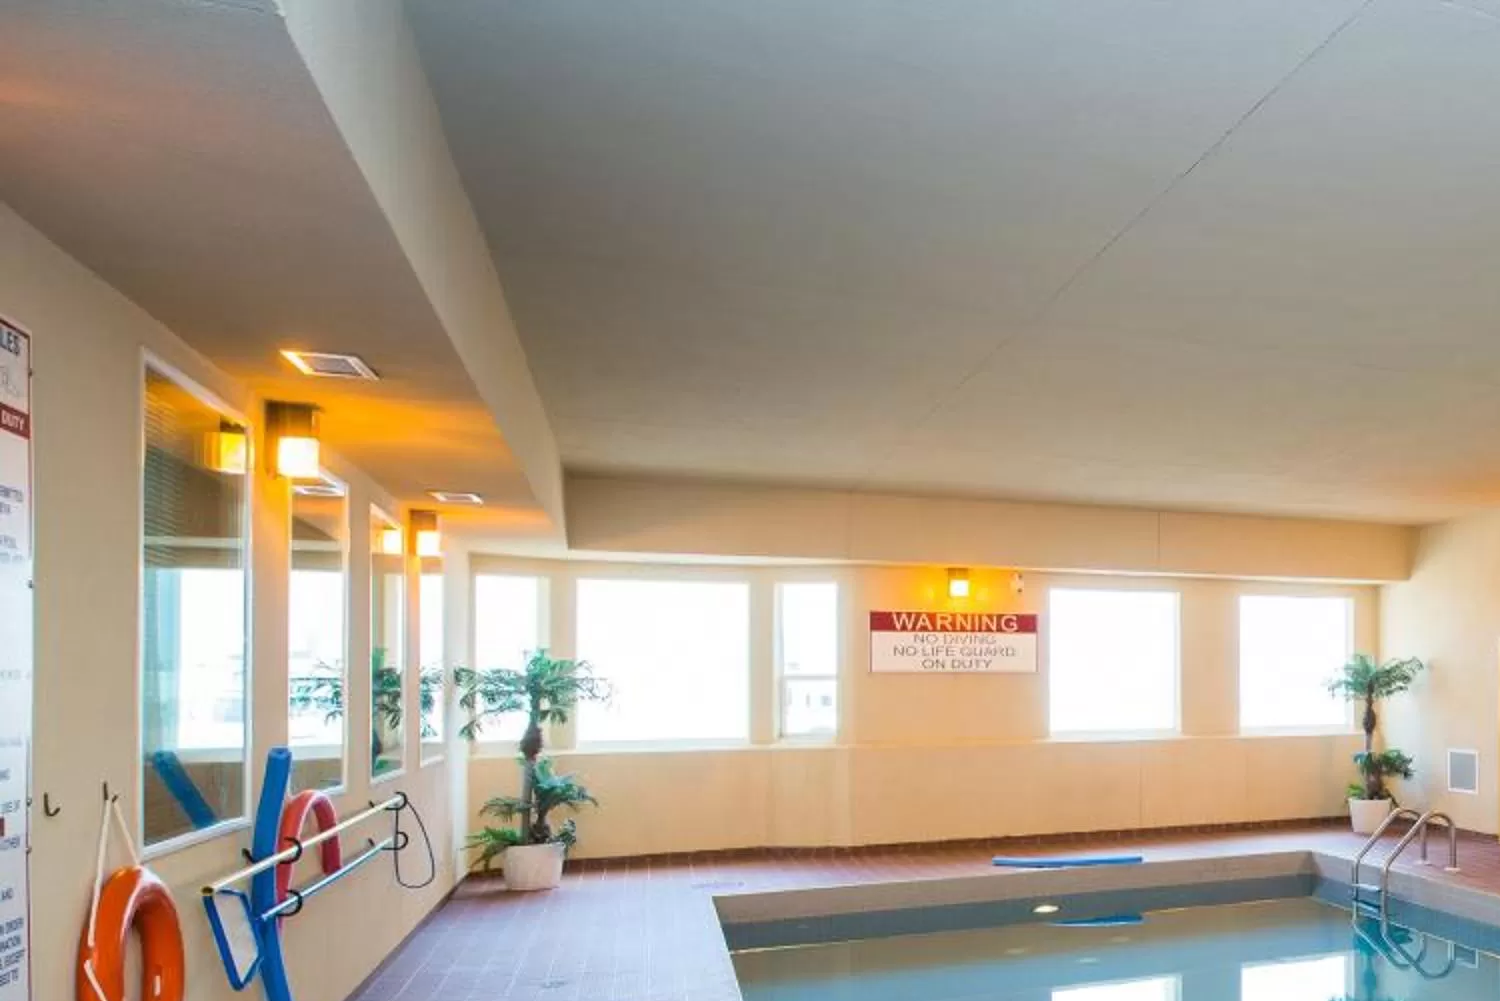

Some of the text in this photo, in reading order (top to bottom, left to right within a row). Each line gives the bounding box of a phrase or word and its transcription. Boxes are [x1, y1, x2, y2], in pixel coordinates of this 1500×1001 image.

[892, 612, 1019, 632] WARNING
[913, 634, 997, 645] NO DIVING
[893, 645, 1016, 657] NO LIFE GUARD
[921, 659, 992, 669] ON DUTY
